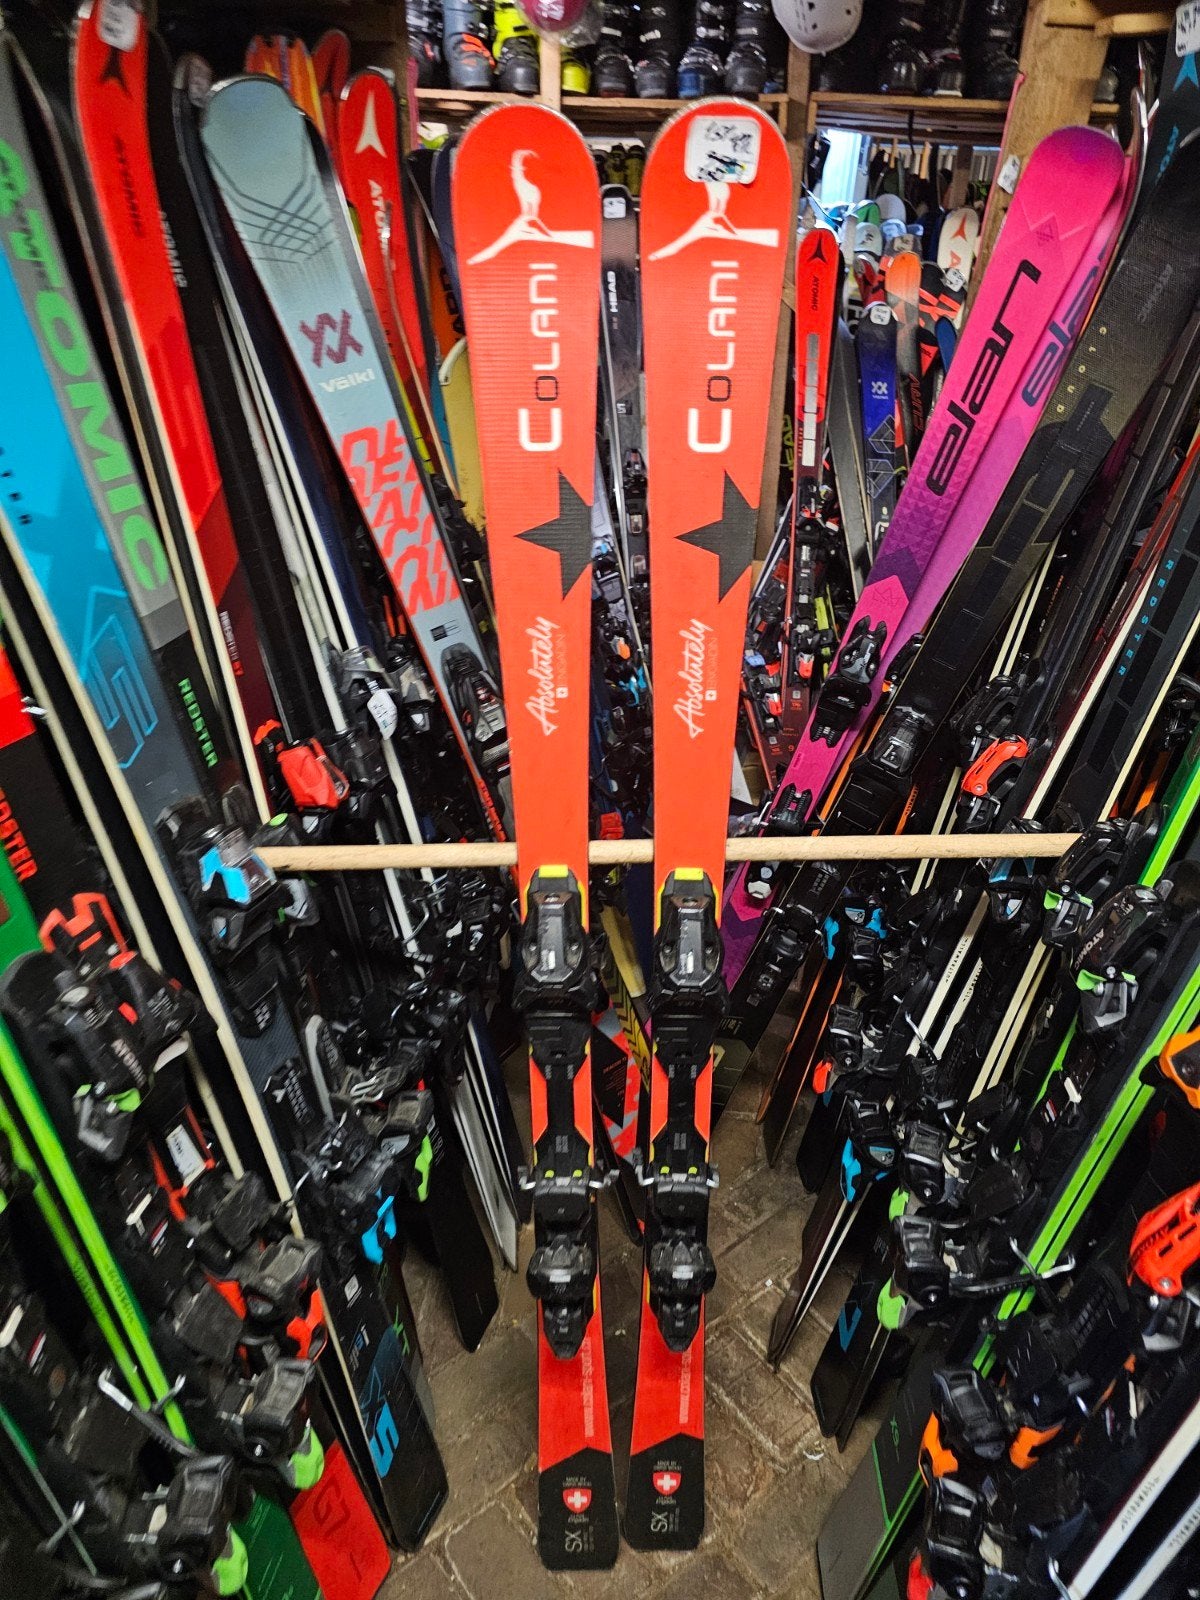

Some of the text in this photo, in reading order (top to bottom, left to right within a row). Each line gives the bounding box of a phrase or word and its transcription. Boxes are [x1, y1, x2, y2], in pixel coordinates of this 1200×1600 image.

[607, 270, 618, 312] HEAD
[811, 275, 820, 312] ATOMIC
[518, 262, 562, 452] COLANI
[687, 260, 740, 453] COLANI
[926, 258, 1042, 497] elan
[1056, 326, 1108, 413] CLOUD
[1117, 559, 1174, 677] REDSTER
[525, 616, 561, 737] Absolutely
[673, 618, 715, 739] Absolutely
[178, 678, 218, 768] REDSTER
[1074, 928, 1104, 971] ATOMIC
[564, 1529, 583, 1552] SX
[650, 1511, 669, 1533] SX
